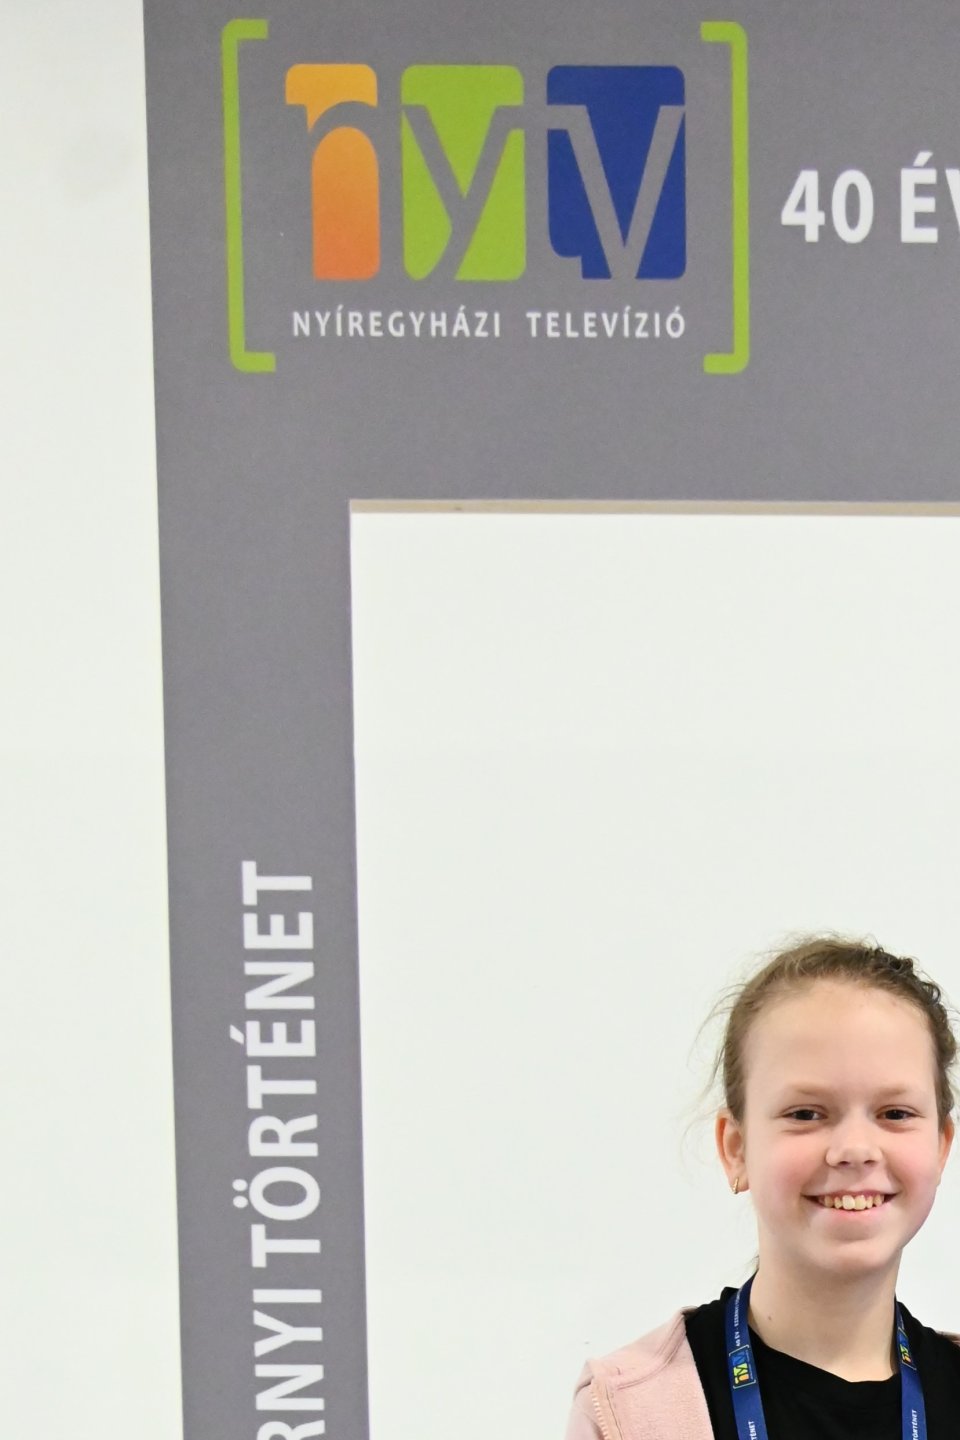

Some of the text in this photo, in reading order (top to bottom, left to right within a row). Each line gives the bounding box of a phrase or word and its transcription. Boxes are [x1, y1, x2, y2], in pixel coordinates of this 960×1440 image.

[782, 170, 873, 243] 40
[292, 305, 686, 339] NYÍREGYHÁZI TELEVÍZIÓ
[229, 860, 321, 1267] TÖRTÉNET
